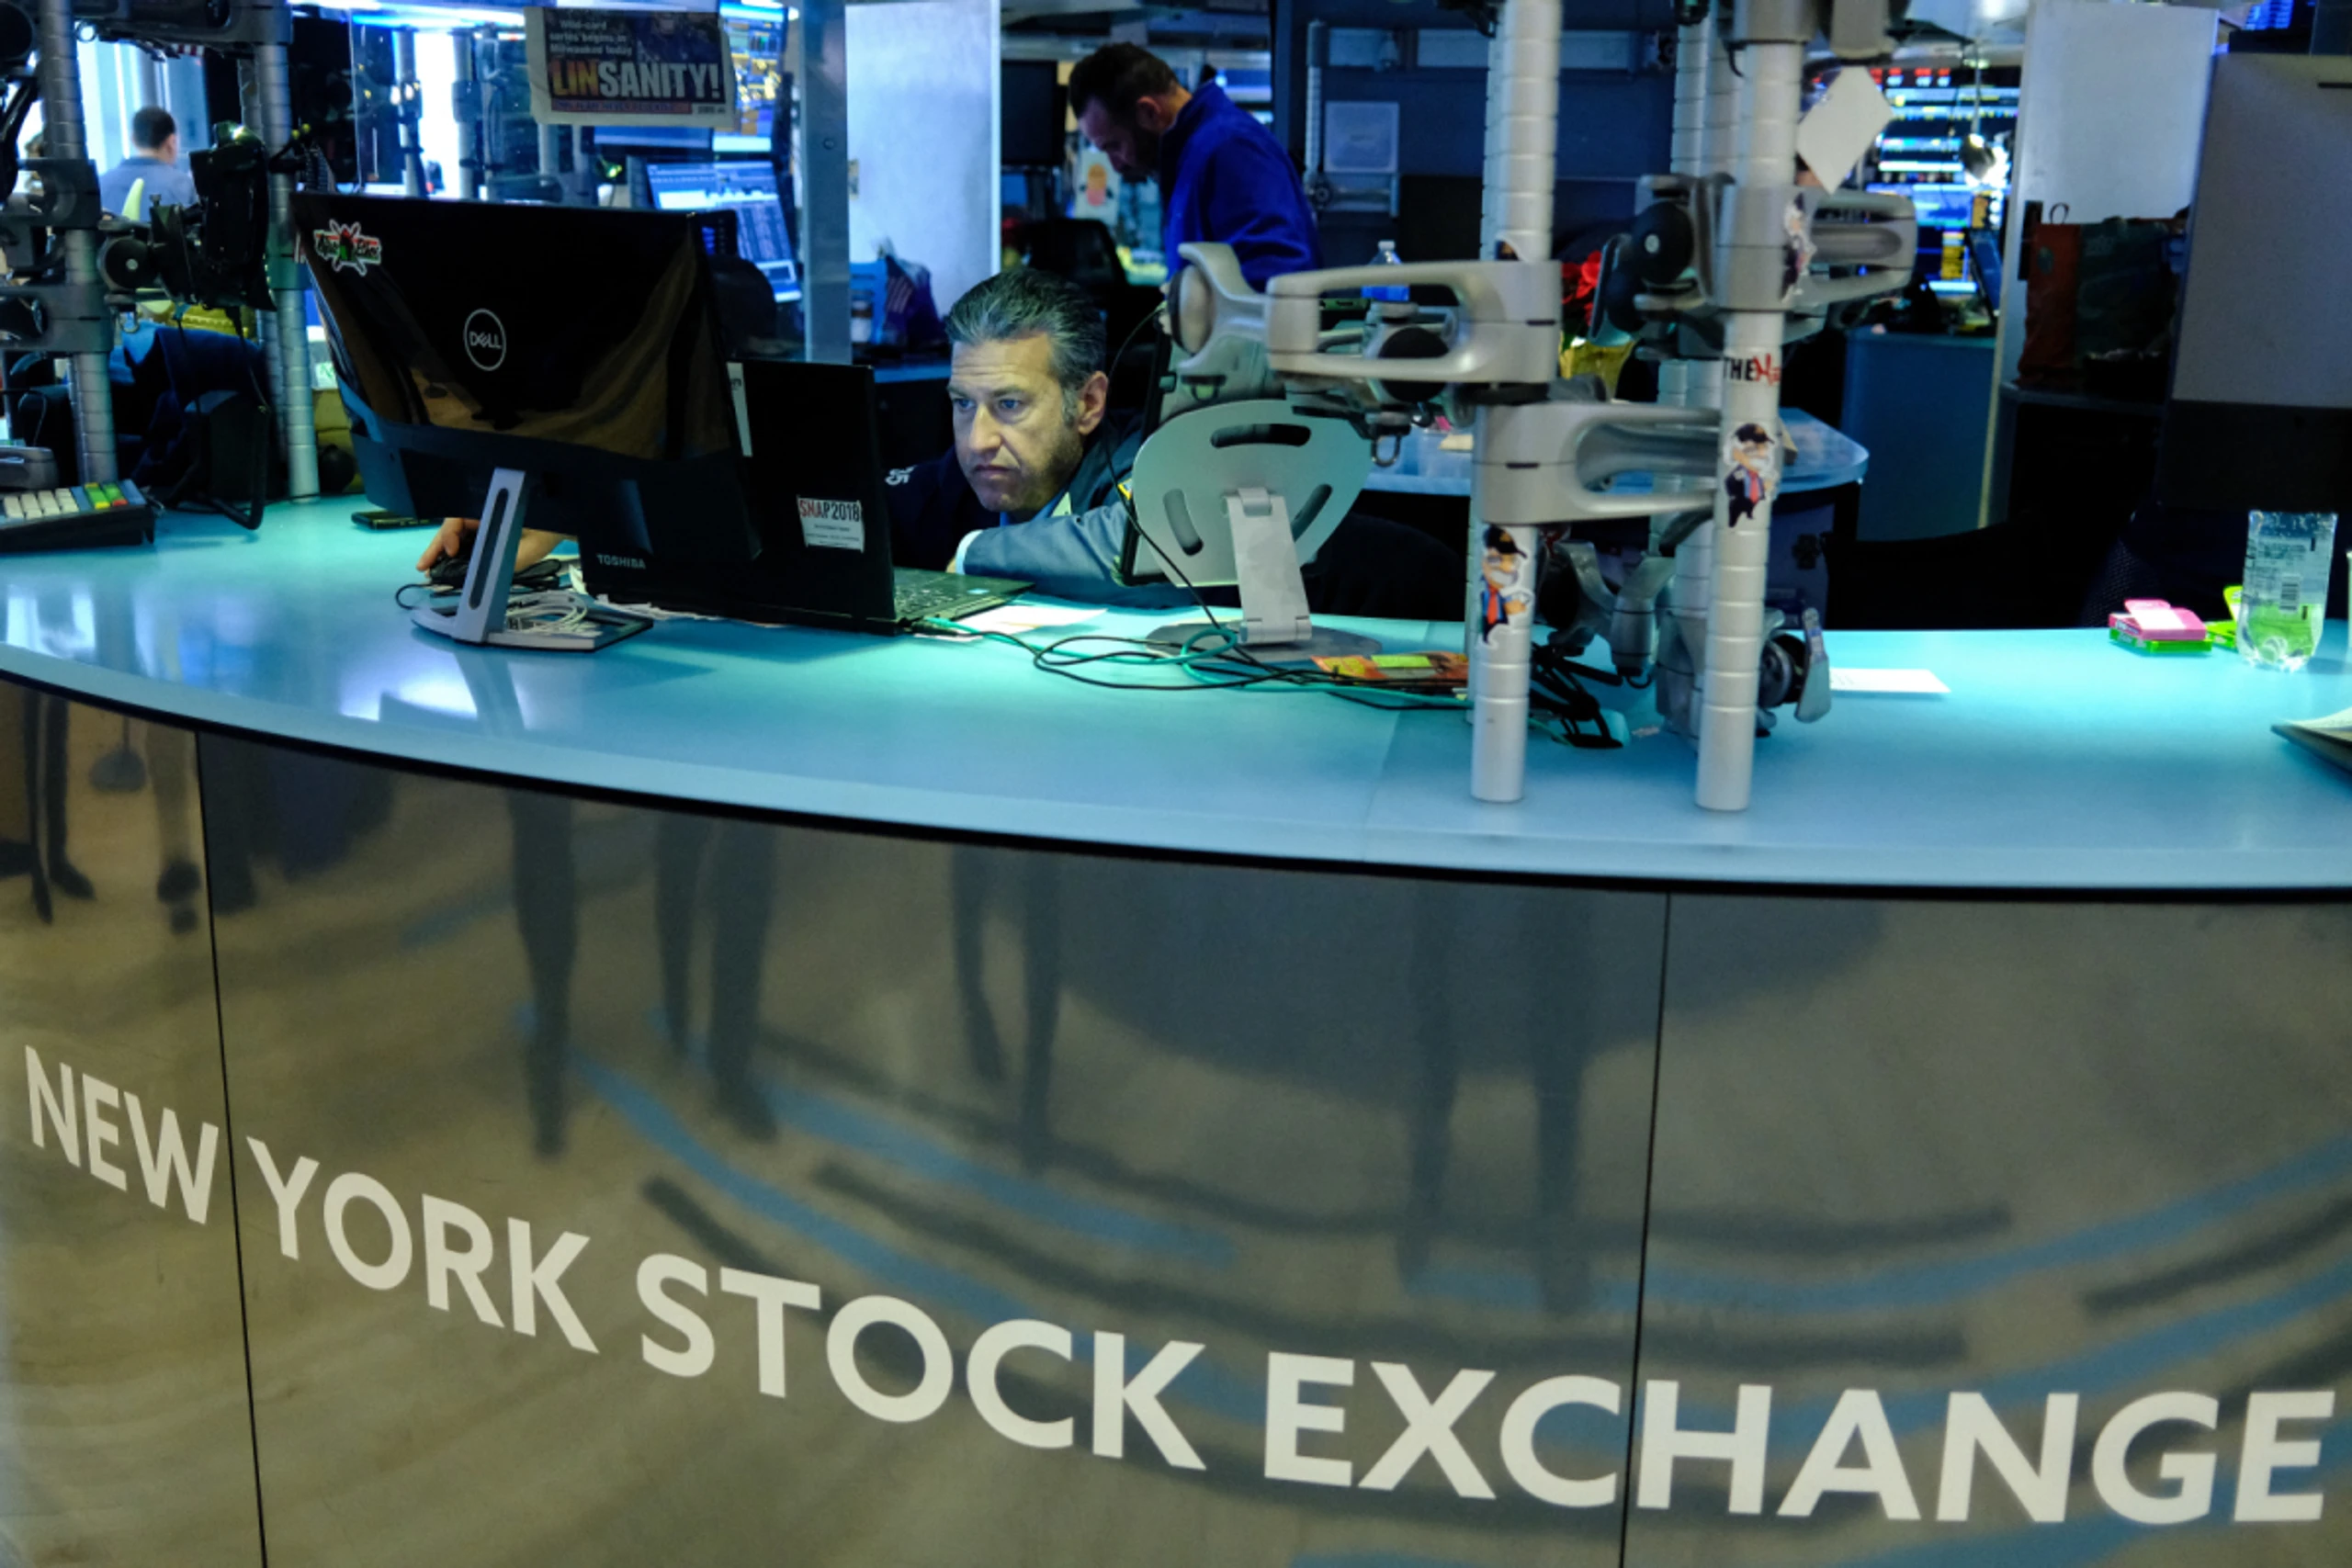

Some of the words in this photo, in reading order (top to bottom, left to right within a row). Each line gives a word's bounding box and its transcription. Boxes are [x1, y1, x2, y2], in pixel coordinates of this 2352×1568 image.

[550, 60, 721, 98] LINSANITY!
[469, 331, 503, 349] DELL
[596, 554, 646, 570] TOSHIBA
[25, 1044, 220, 1224] NEW
[246, 1135, 600, 1353] YORK
[636, 1252, 1207, 1472] STOCK
[1263, 1350, 2335, 1525] EXCHANGE
